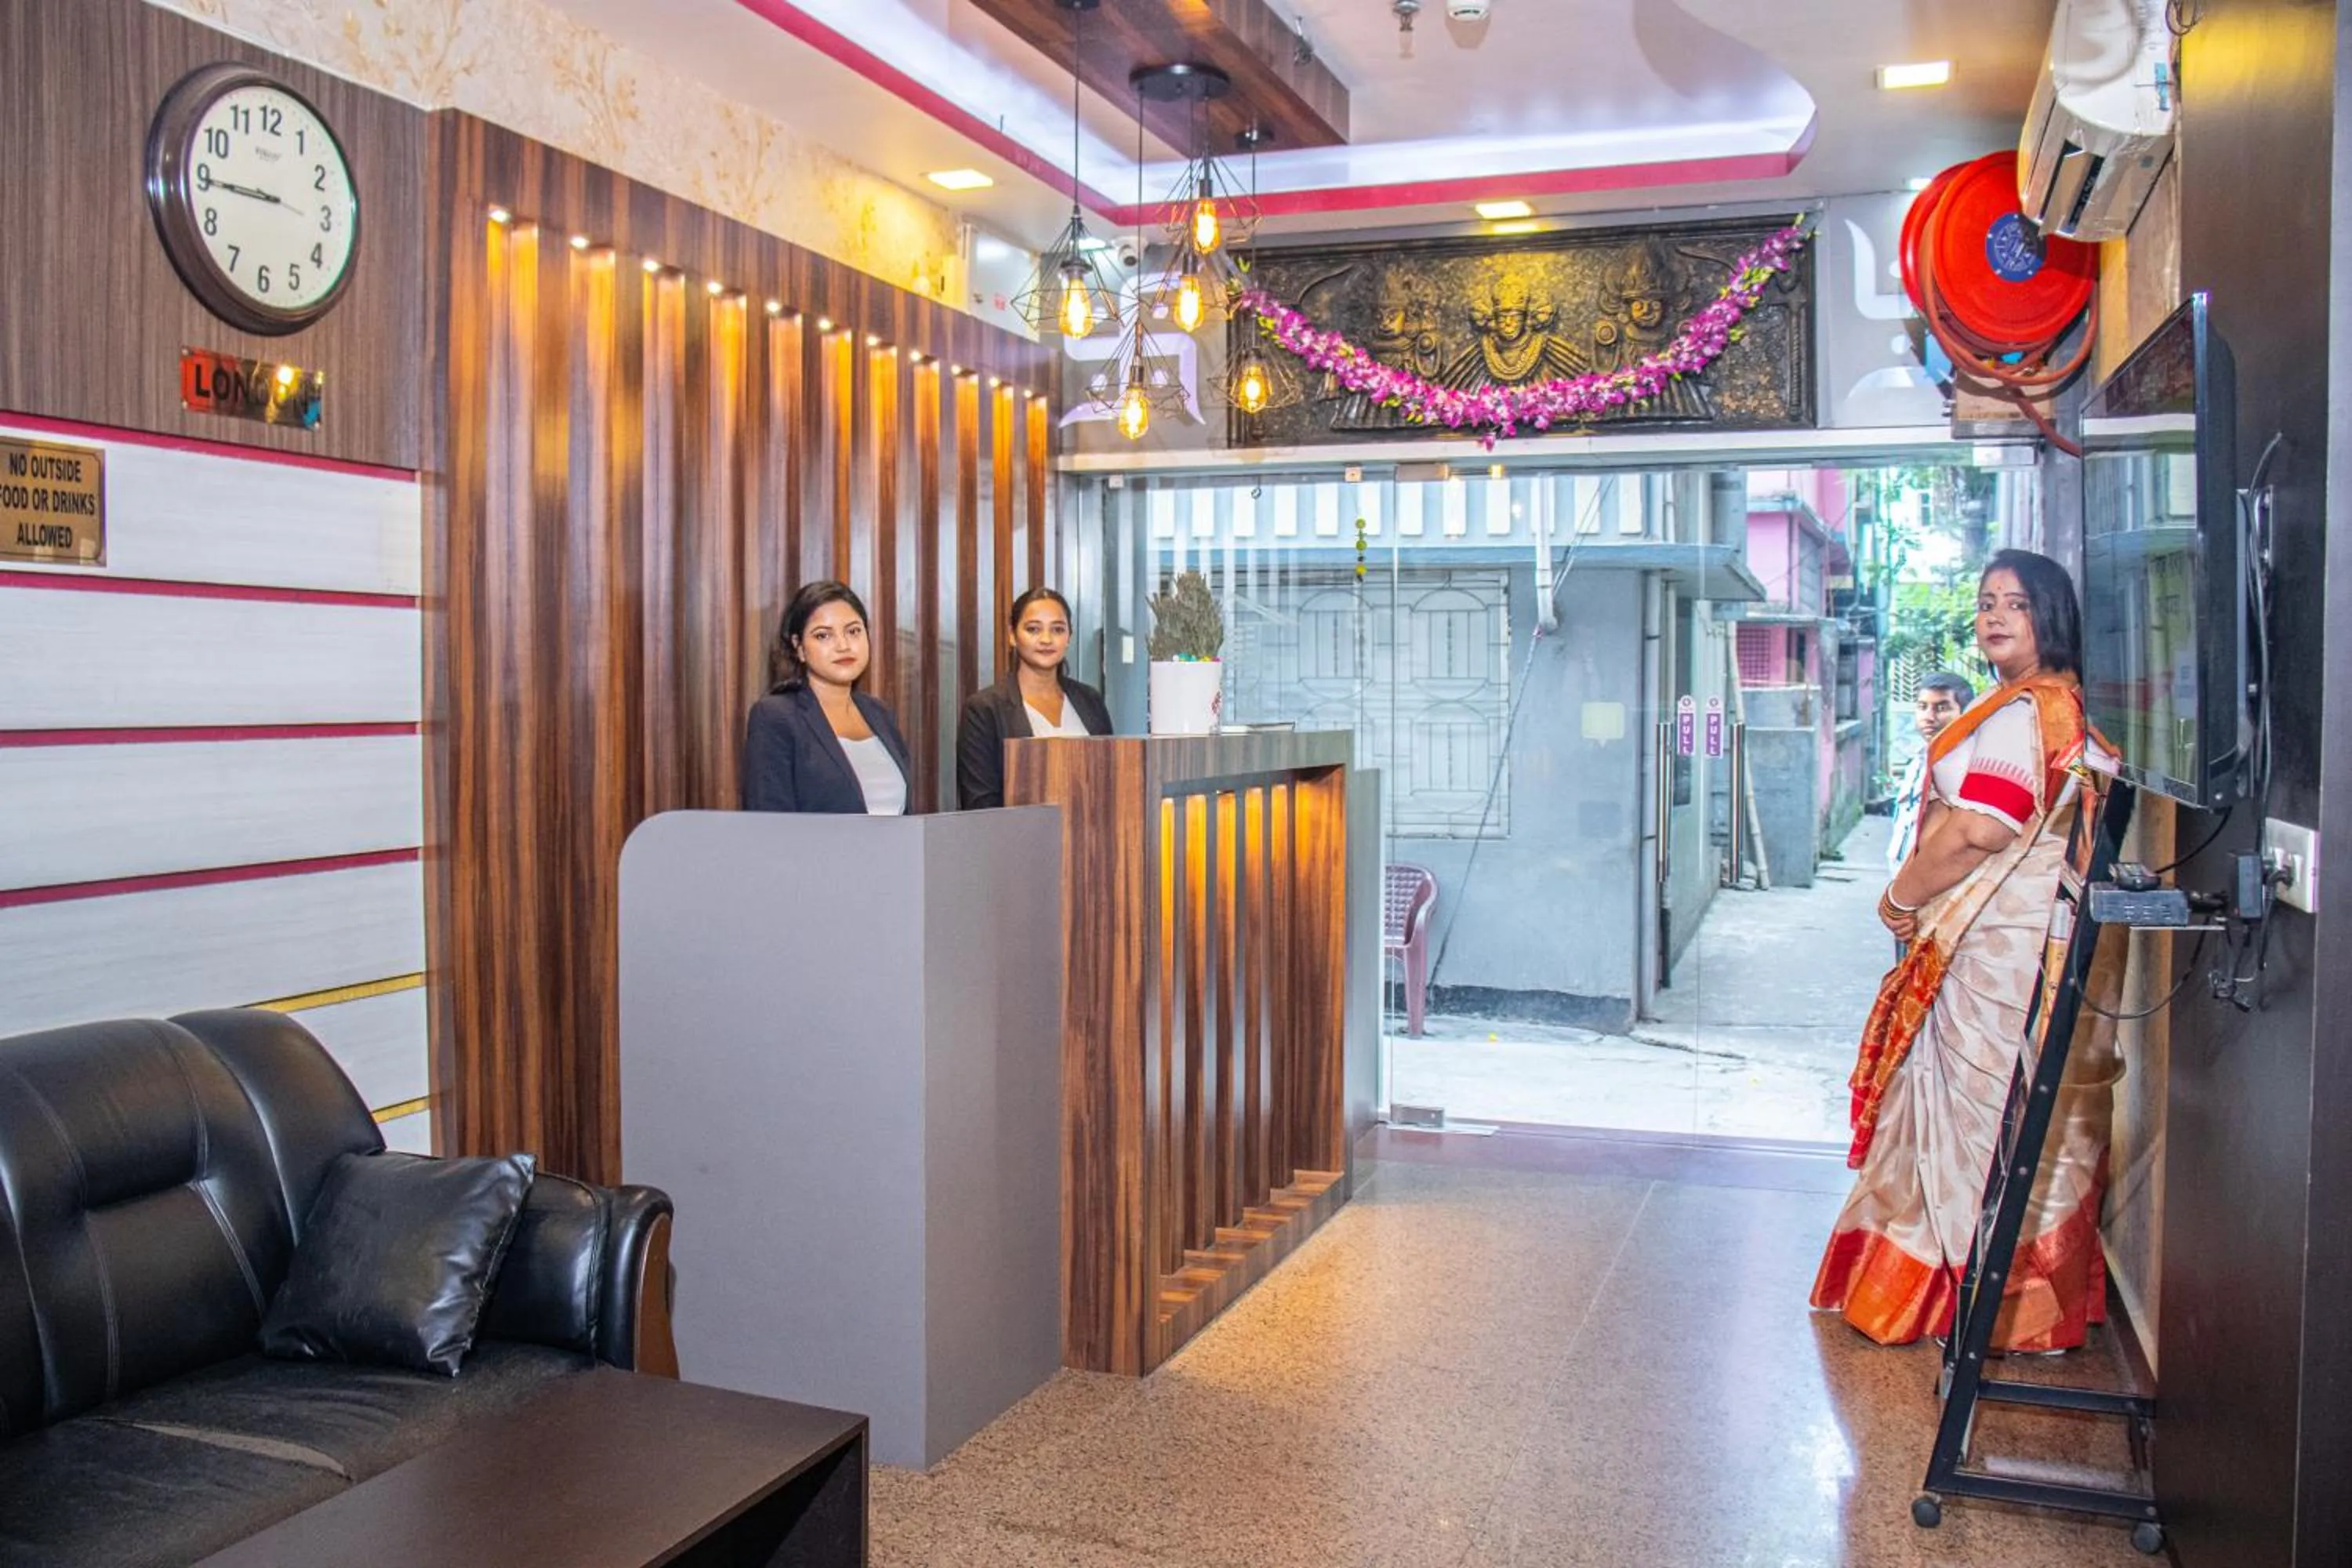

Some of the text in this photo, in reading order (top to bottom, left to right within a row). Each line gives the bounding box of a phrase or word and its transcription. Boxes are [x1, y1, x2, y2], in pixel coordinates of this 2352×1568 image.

[230, 104, 251, 135] 11
[259, 105, 282, 136] 12
[204, 129, 230, 158] 10
[295, 129, 305, 155] 1
[197, 163, 211, 191] 9
[314, 165, 326, 191] 2
[204, 208, 217, 236] 8
[319, 205, 332, 233] 3
[227, 245, 240, 273] 7
[310, 242, 324, 269] 4
[257, 266, 270, 293] 6
[289, 263, 301, 291] 5
[9, 452, 82, 483] NO OUTSIDE
[0, 484, 95, 516] OOD OR DRINKS
[17, 523, 72, 548] ALLOWED
